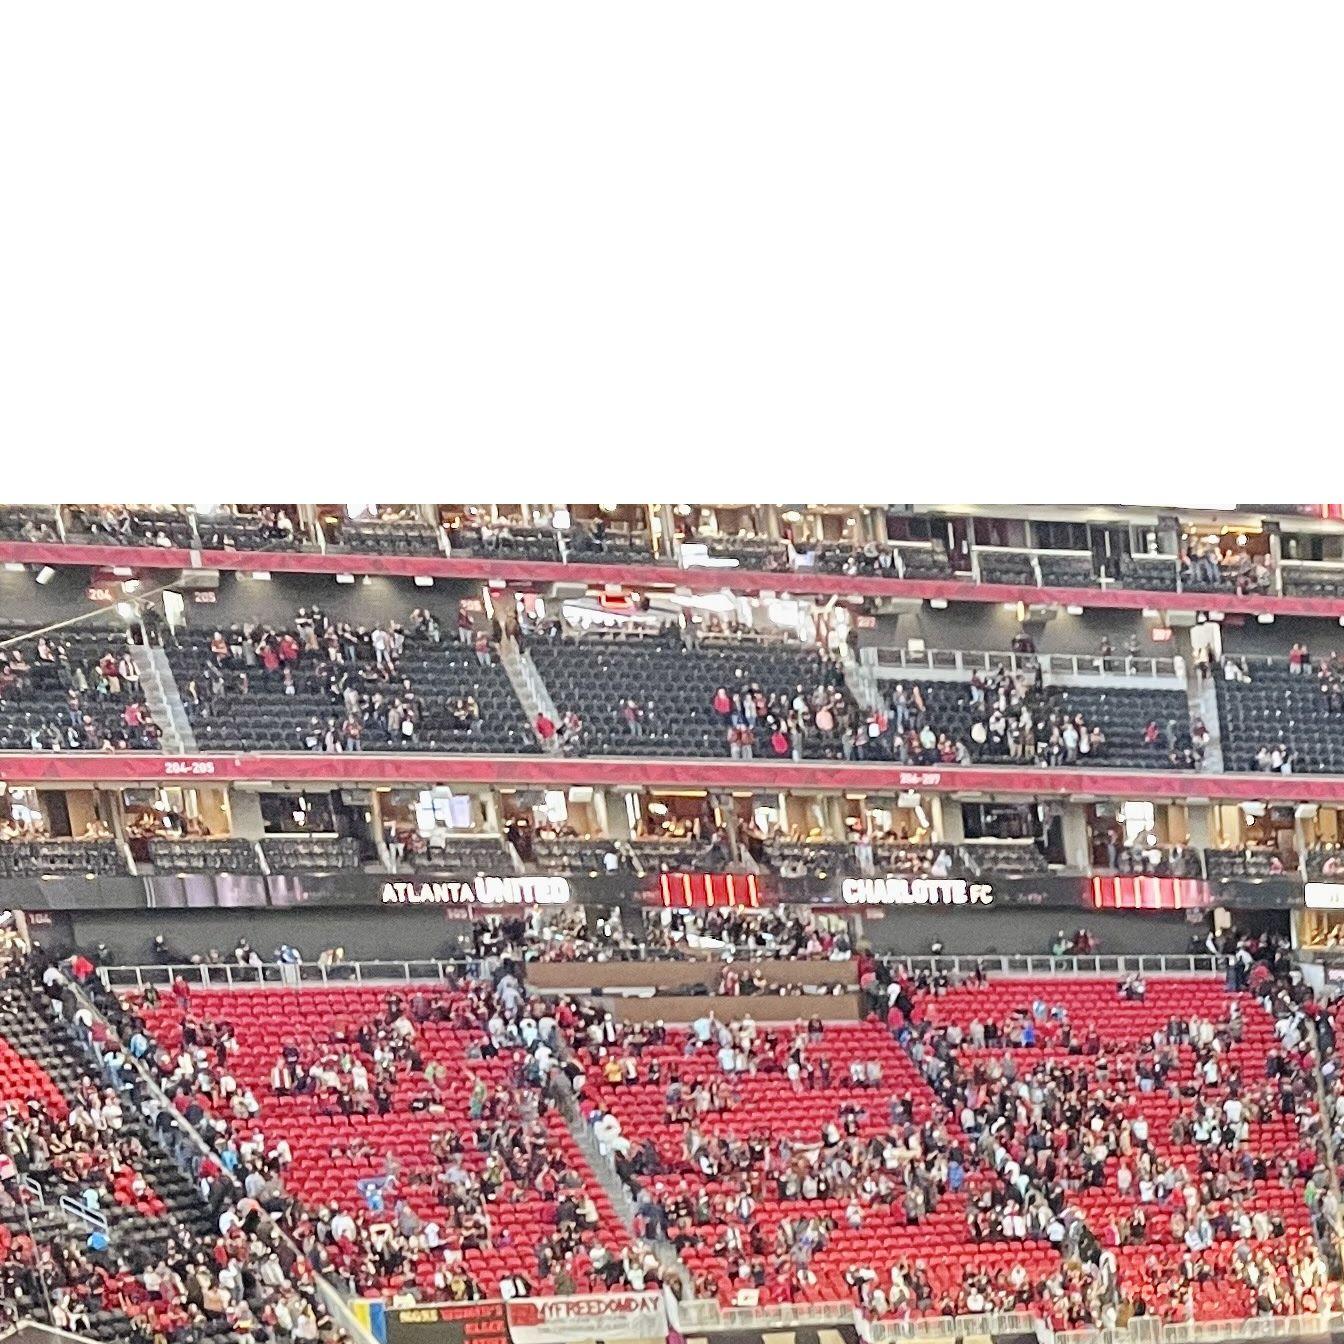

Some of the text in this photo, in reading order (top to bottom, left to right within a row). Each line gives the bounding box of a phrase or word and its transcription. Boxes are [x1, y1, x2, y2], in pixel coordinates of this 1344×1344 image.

[165, 762, 214, 774] 204-205
[382, 877, 570, 904] ATLANTA UNITED
[842, 878, 993, 904] CHARLOTTE FC
